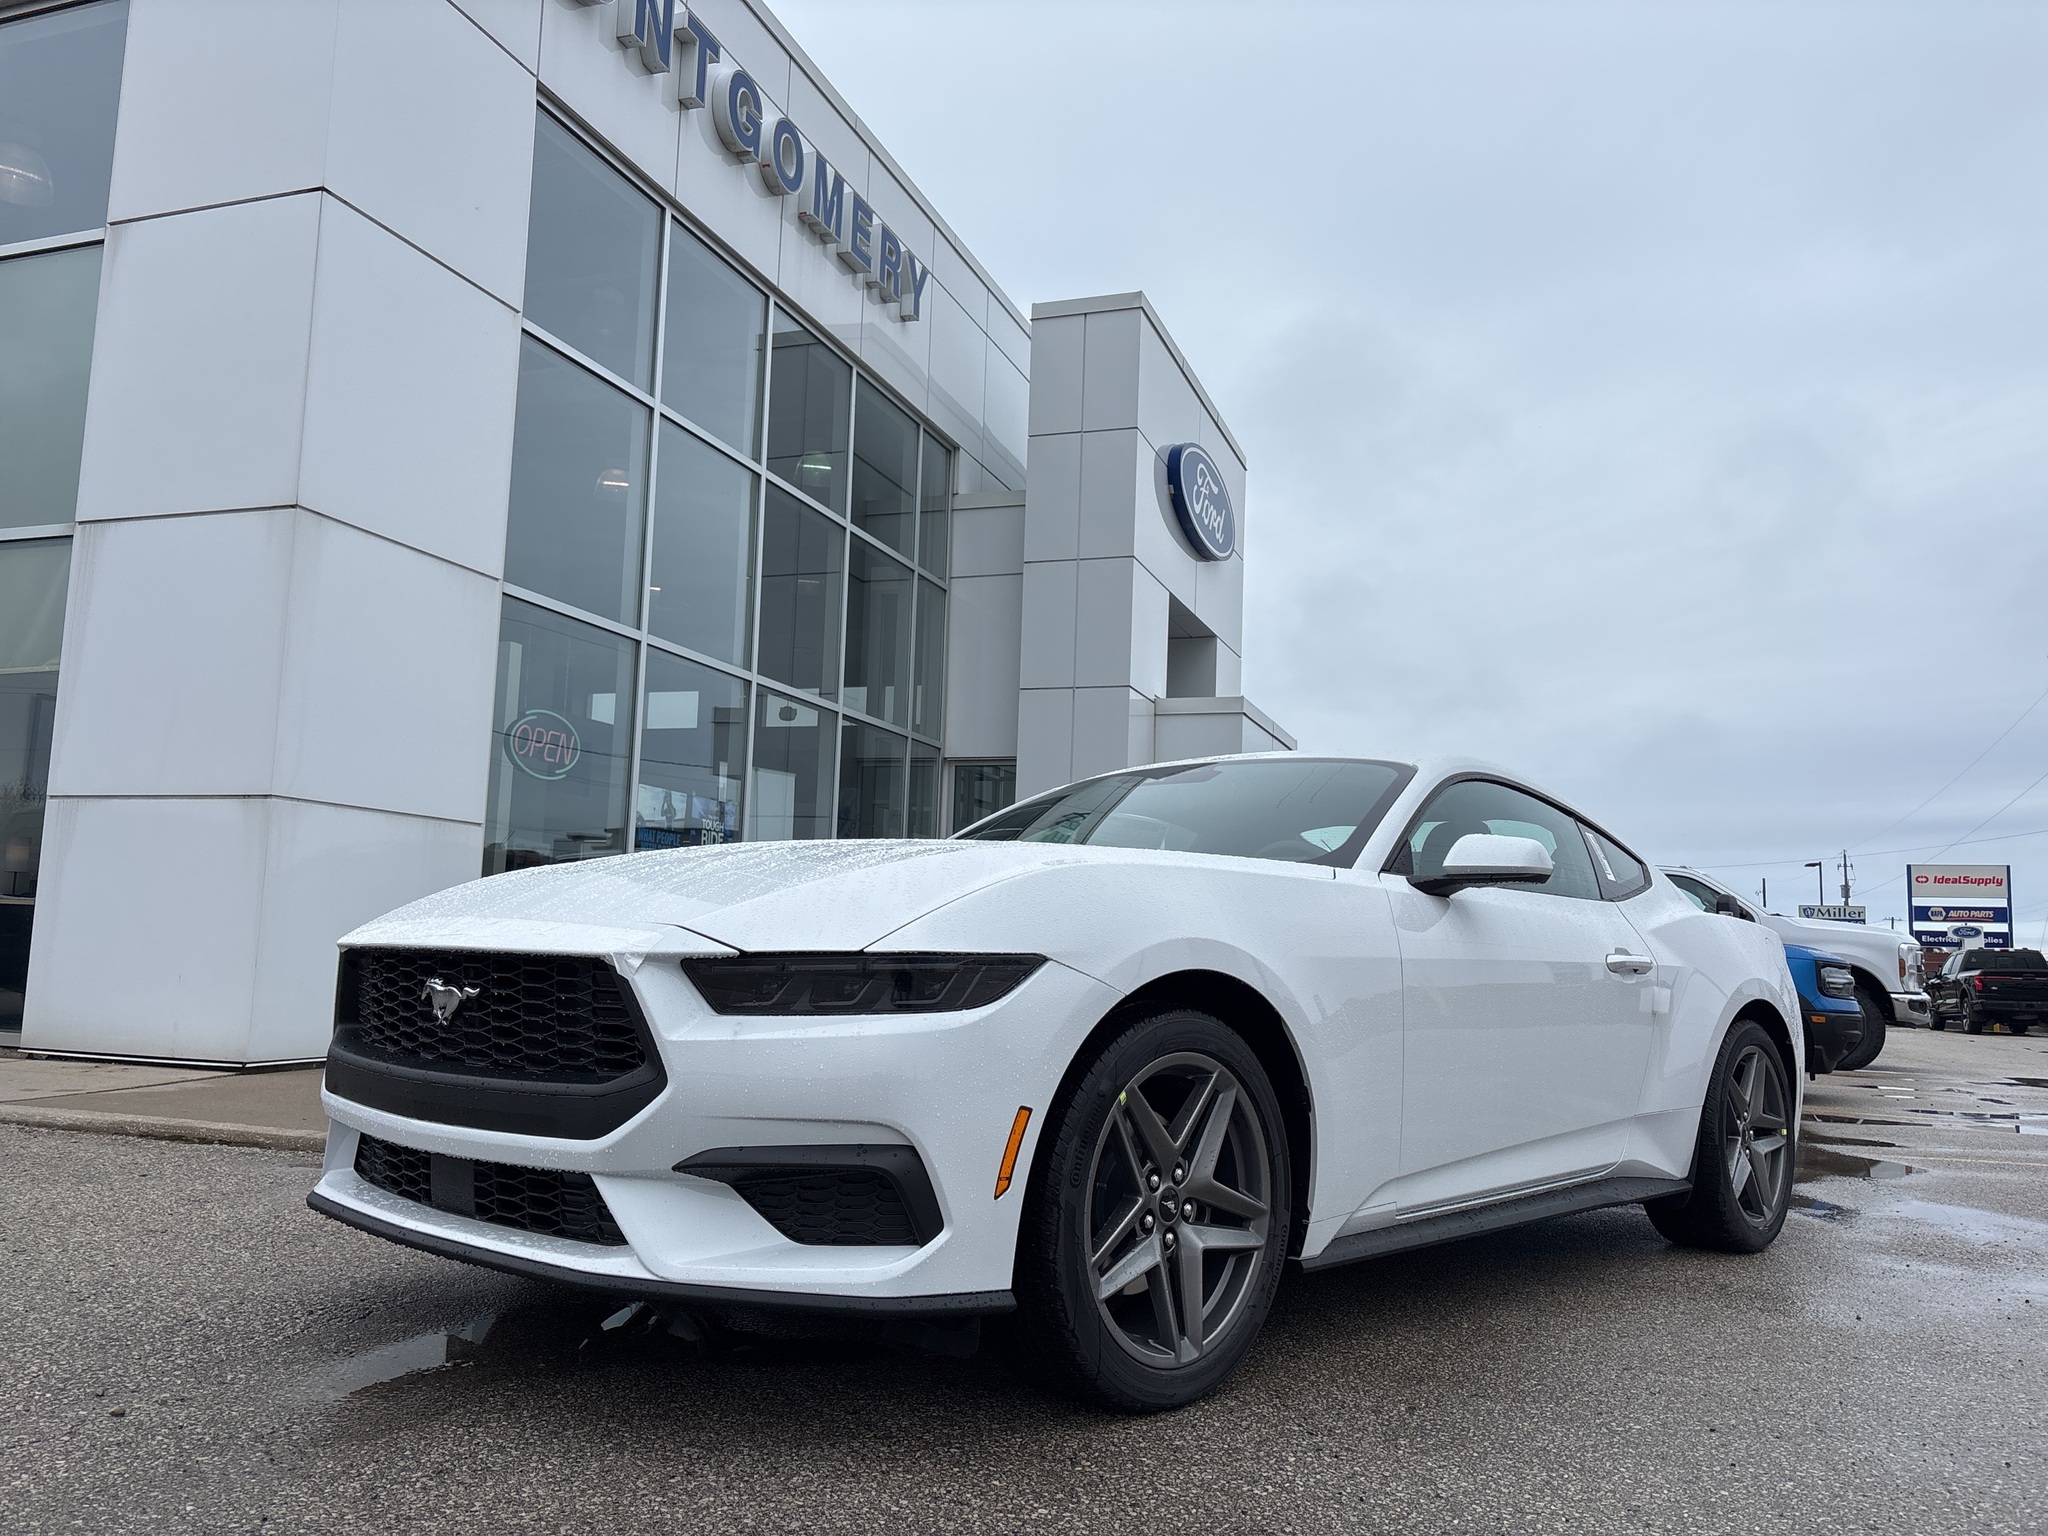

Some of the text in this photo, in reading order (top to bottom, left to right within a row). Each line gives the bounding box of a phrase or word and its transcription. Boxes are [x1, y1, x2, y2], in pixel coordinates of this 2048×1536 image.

[578, 0, 929, 322] NTGOMERY
[1193, 463, 1226, 544] Ford
[514, 724, 576, 765] OPEN
[702, 818, 725, 833] TOUGH
[638, 827, 656, 842] WHAT
[656, 830, 681, 846] PEOPLE
[1933, 875, 2004, 887] IdealSupply
[1816, 907, 1864, 918] Miller
[1930, 910, 1994, 919] NAPA AUTO PARTS
[1921, 935, 1961, 943] Electrica
